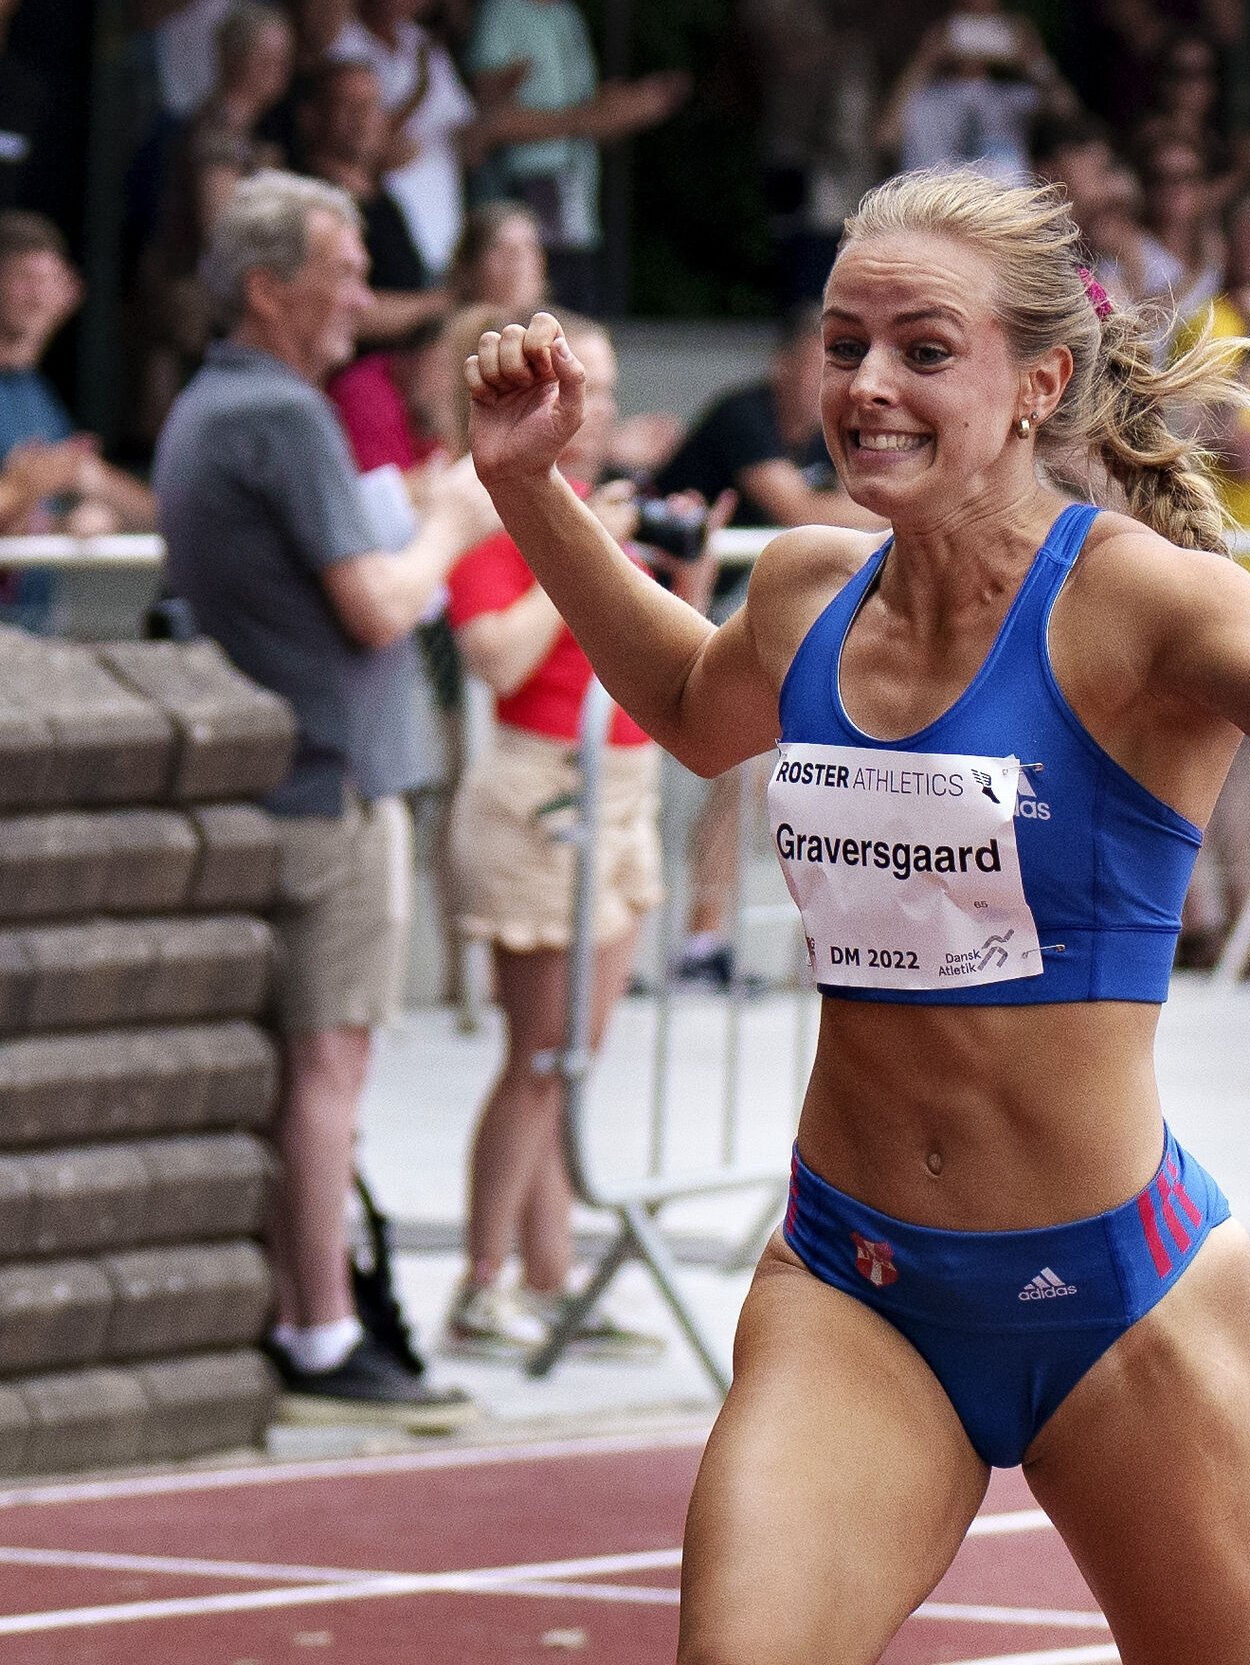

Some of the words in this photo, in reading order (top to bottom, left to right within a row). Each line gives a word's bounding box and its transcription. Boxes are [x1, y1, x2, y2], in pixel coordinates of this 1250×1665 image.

[776, 761, 849, 788] ROSTER
[853, 767, 964, 797] ATHLETICS
[1014, 799, 1051, 821] as
[776, 823, 1002, 880] Graversgaard
[830, 946, 861, 966] DM
[867, 949, 921, 970] 2022
[945, 948, 982, 964] Dansk
[938, 964, 977, 977] Atletik
[1018, 1283, 1077, 1301] adidas
